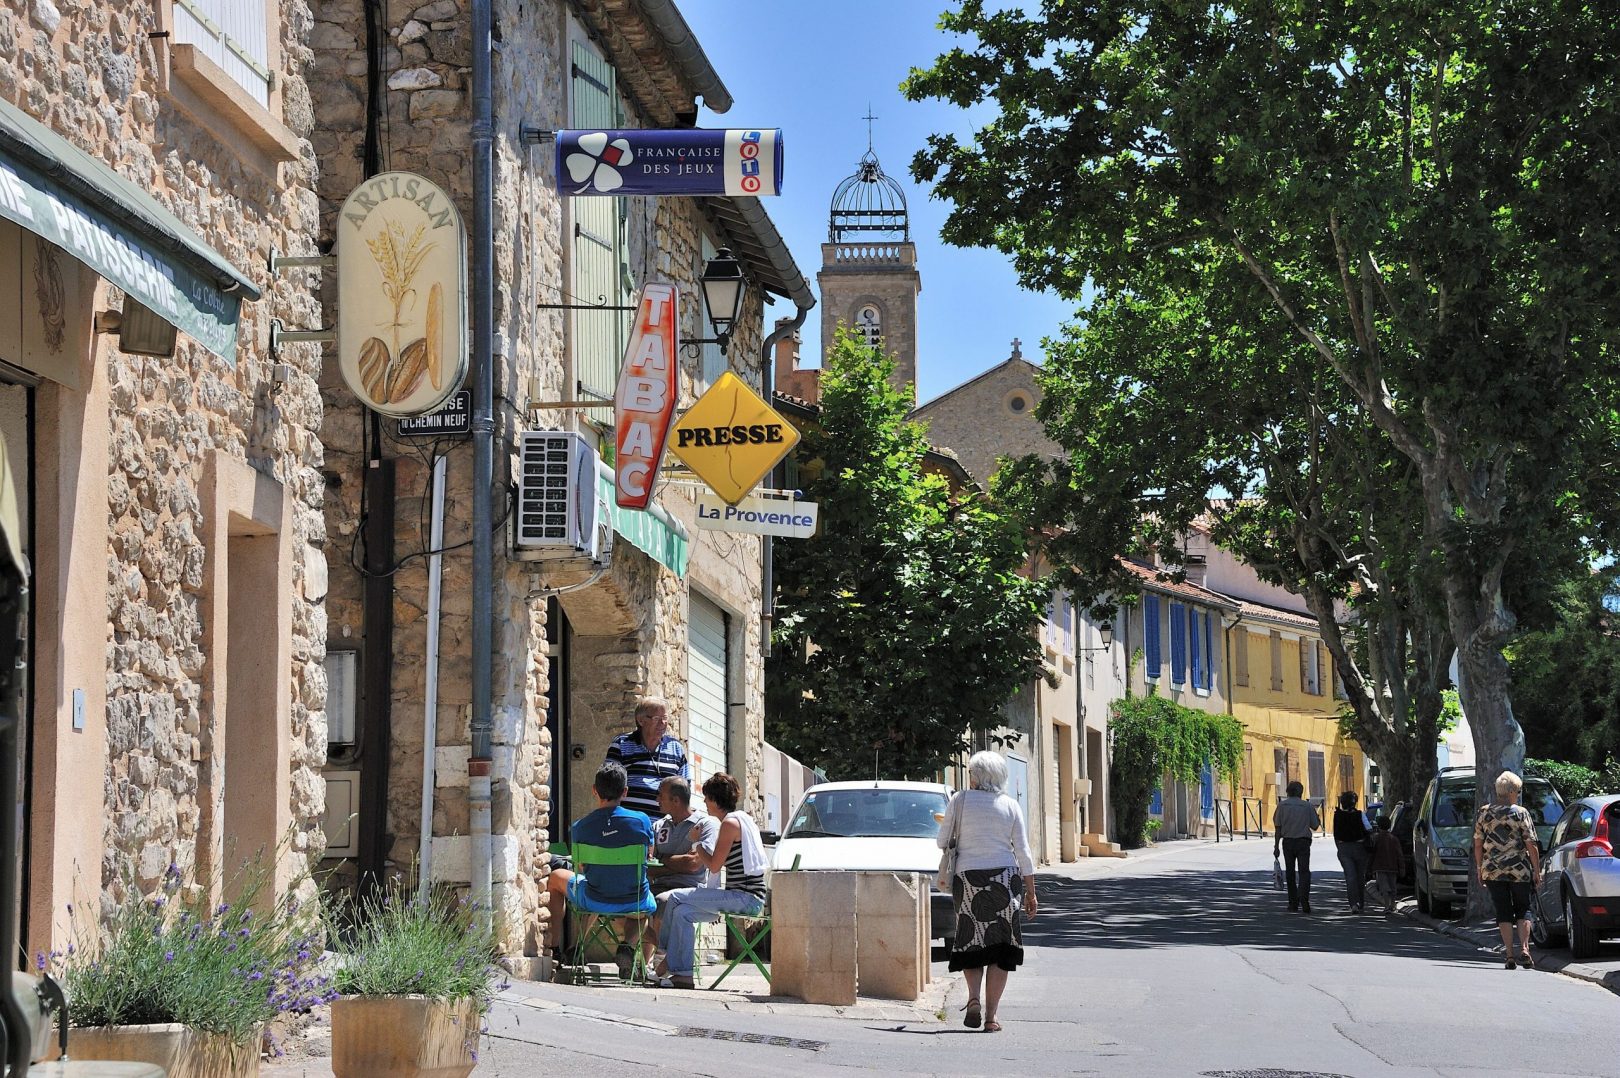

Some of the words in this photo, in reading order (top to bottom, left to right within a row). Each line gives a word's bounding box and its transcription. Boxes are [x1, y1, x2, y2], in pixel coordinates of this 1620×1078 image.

[643, 163, 670, 174] DES
[678, 163, 715, 176] JEUX
[740, 131, 761, 193] LOTO
[344, 176, 453, 231] ARTISAN
[44, 189, 179, 316] PATISSERIE
[619, 290, 671, 497] TABAC
[409, 414, 442, 429] CHEMIN
[444, 413, 467, 427] NEUF
[677, 424, 783, 448] PRESSE
[698, 503, 720, 520] La
[724, 505, 813, 527] Provence
[659, 828, 669, 843] 3
